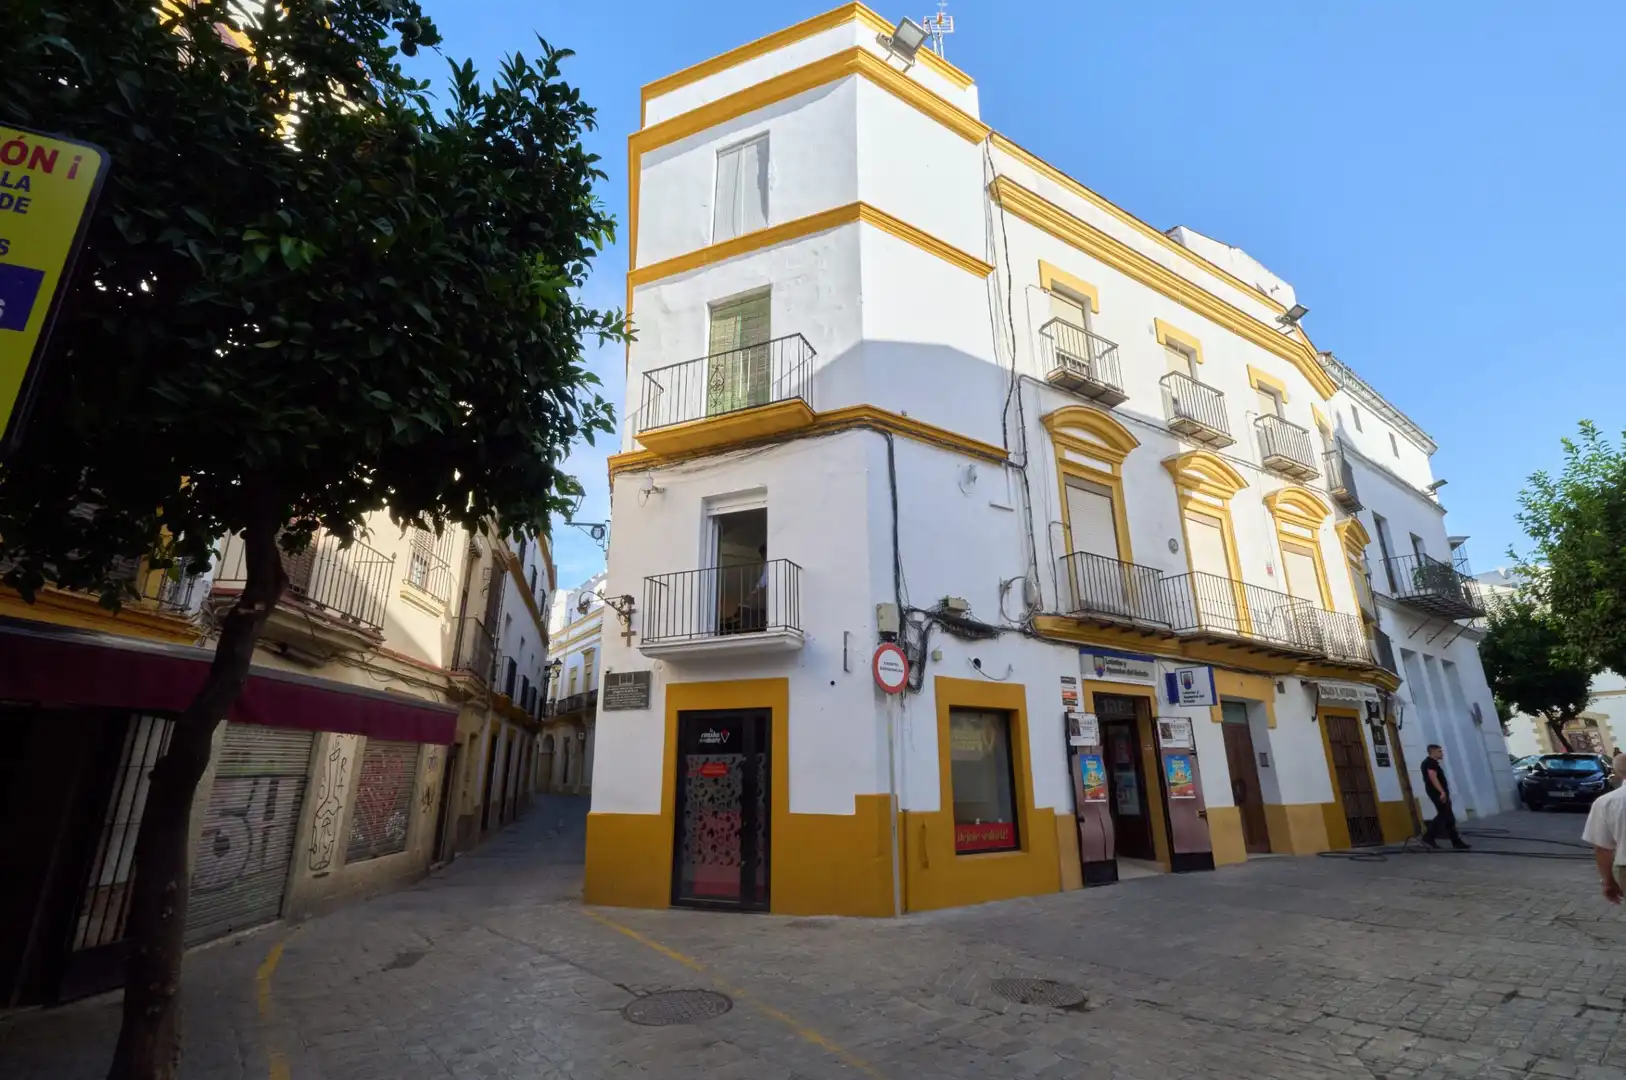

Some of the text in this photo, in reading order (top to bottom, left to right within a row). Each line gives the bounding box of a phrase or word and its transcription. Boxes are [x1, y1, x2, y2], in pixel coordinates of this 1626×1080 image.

[0, 134, 60, 174] ÓN
[0, 170, 31, 193] LA
[0, 192, 32, 214] DE
